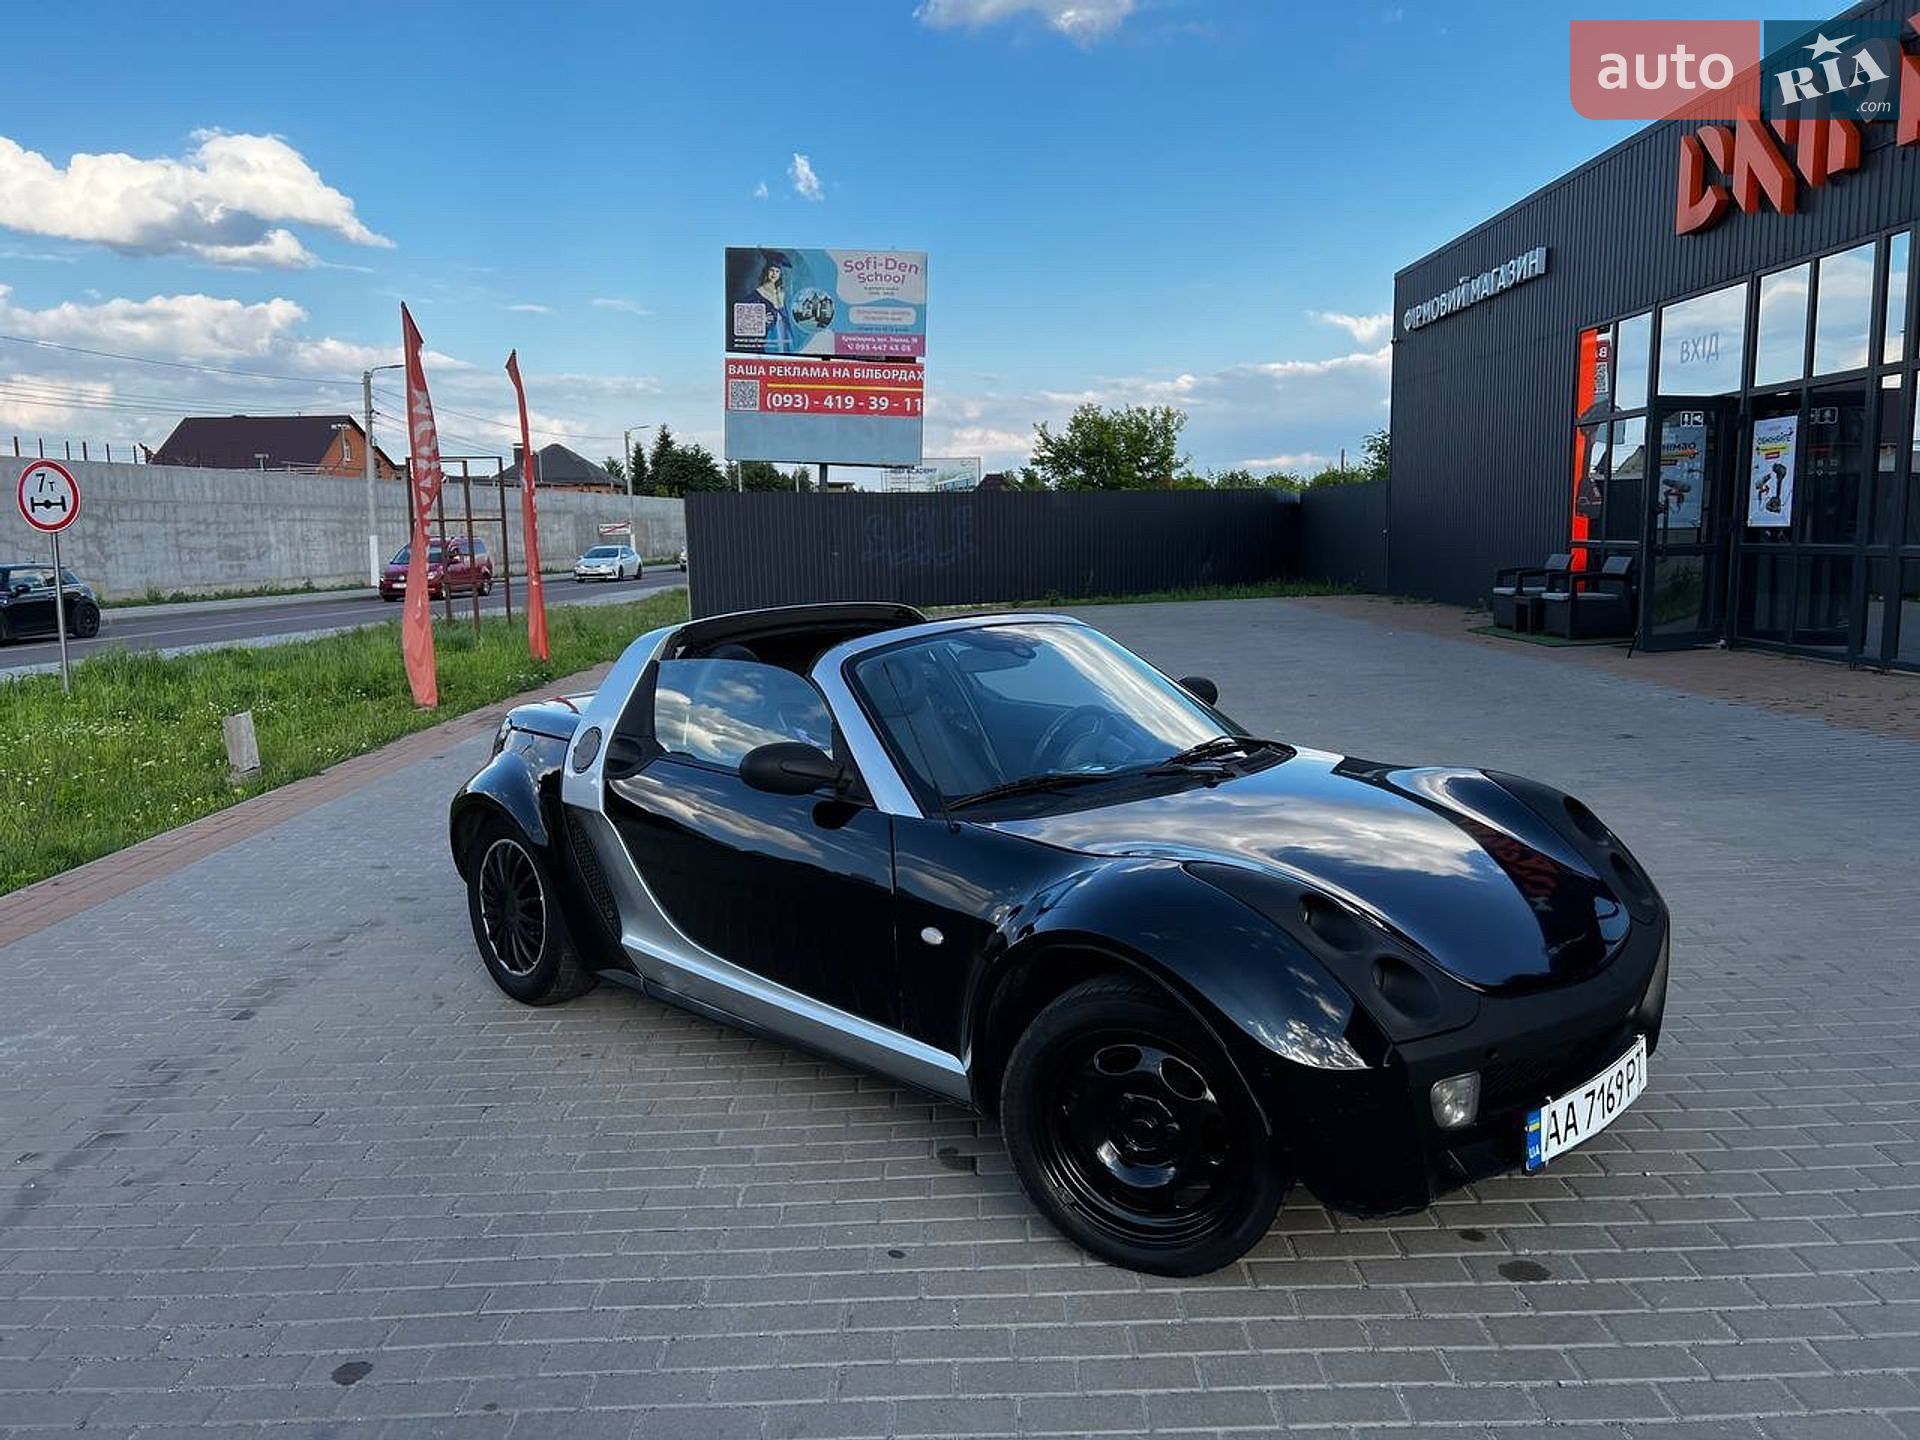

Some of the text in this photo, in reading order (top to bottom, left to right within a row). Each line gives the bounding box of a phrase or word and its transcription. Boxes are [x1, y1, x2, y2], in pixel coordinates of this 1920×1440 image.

[843, 256, 919, 275] Sofi-Den
[857, 271, 906, 284] School
[1404, 246, 1546, 331] ФІРМОВИЙ МАГАЗИН
[1680, 334, 1719, 364] ВХІД
[728, 364, 924, 382] ВАША РЕКЛАМА НА БІЛБОРДАХ
[766, 393, 809, 410] (093)
[823, 395, 854, 410] 419
[868, 396, 889, 411] 39
[904, 398, 921, 412] 11
[1545, 1101, 1579, 1152] AA
[1584, 1069, 1624, 1130] 7169
